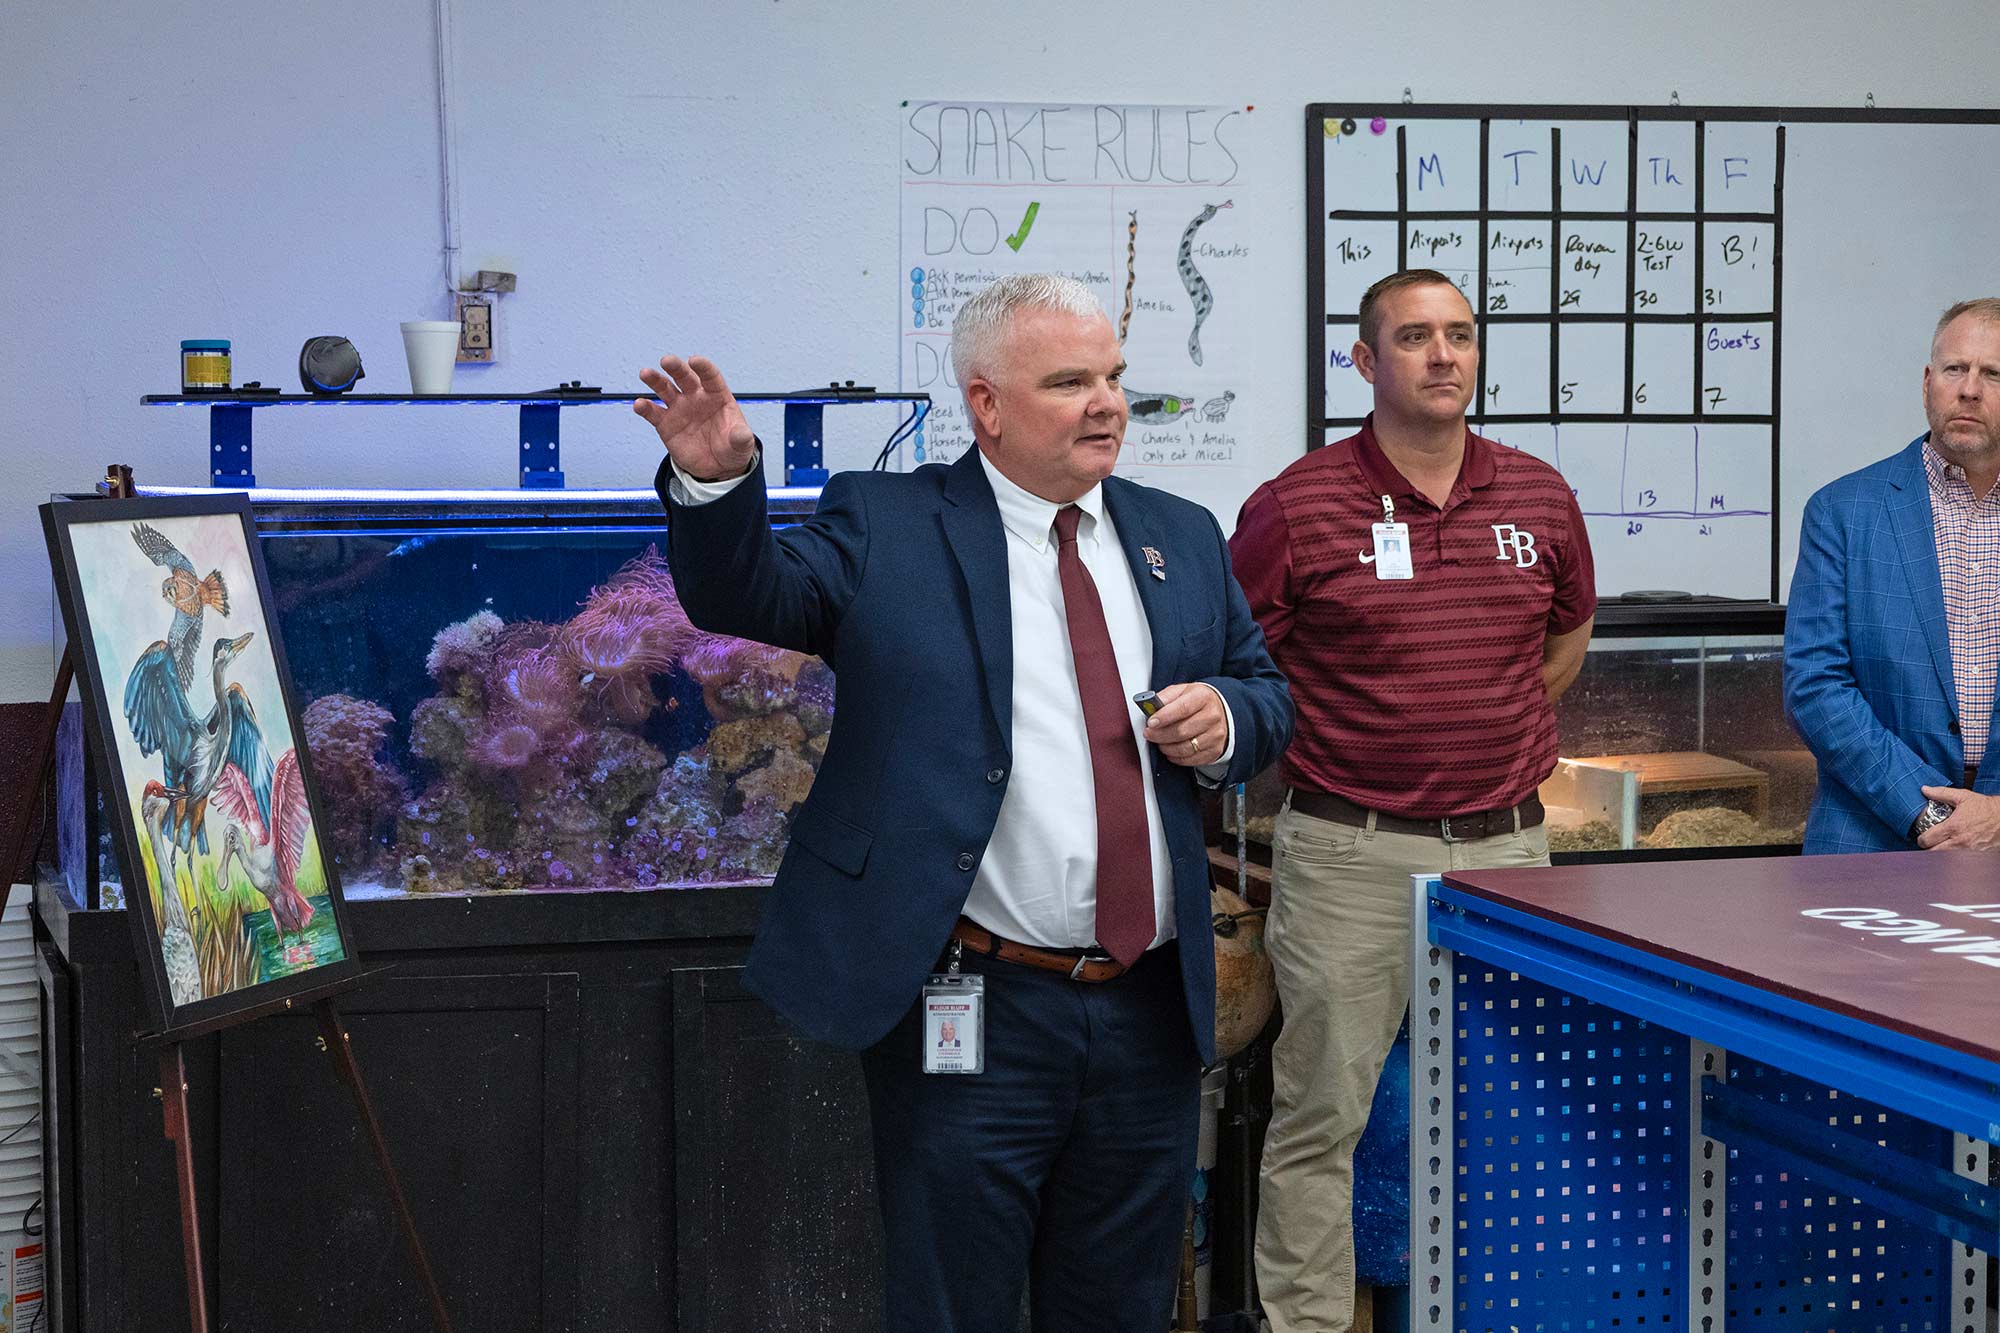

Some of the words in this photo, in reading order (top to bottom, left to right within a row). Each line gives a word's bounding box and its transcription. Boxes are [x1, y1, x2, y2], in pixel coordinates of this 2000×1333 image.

[905, 102, 1070, 182] SNAKE
[1095, 105, 1240, 187] RULES
[1418, 153, 1444, 191] M
[1503, 150, 1538, 186] T
[1571, 158, 1607, 186] W
[1649, 157, 1683, 185] Th
[1723, 158, 1748, 189] F
[924, 207, 999, 256] DO
[1336, 237, 1372, 264] This
[1574, 256, 1602, 279] day
[1560, 289, 1582, 307] 29
[1634, 289, 1658, 307] 30
[1704, 288, 1722, 305] 31
[1707, 327, 1761, 351] Guests
[1487, 384, 1501, 408] 4
[1560, 382, 1579, 404] 5
[1635, 383, 1648, 403] 6
[1704, 387, 1728, 410] 7
[1638, 489, 1658, 508] 13
[1627, 520, 1643, 536] 20
[1491, 523, 1539, 568] FB
